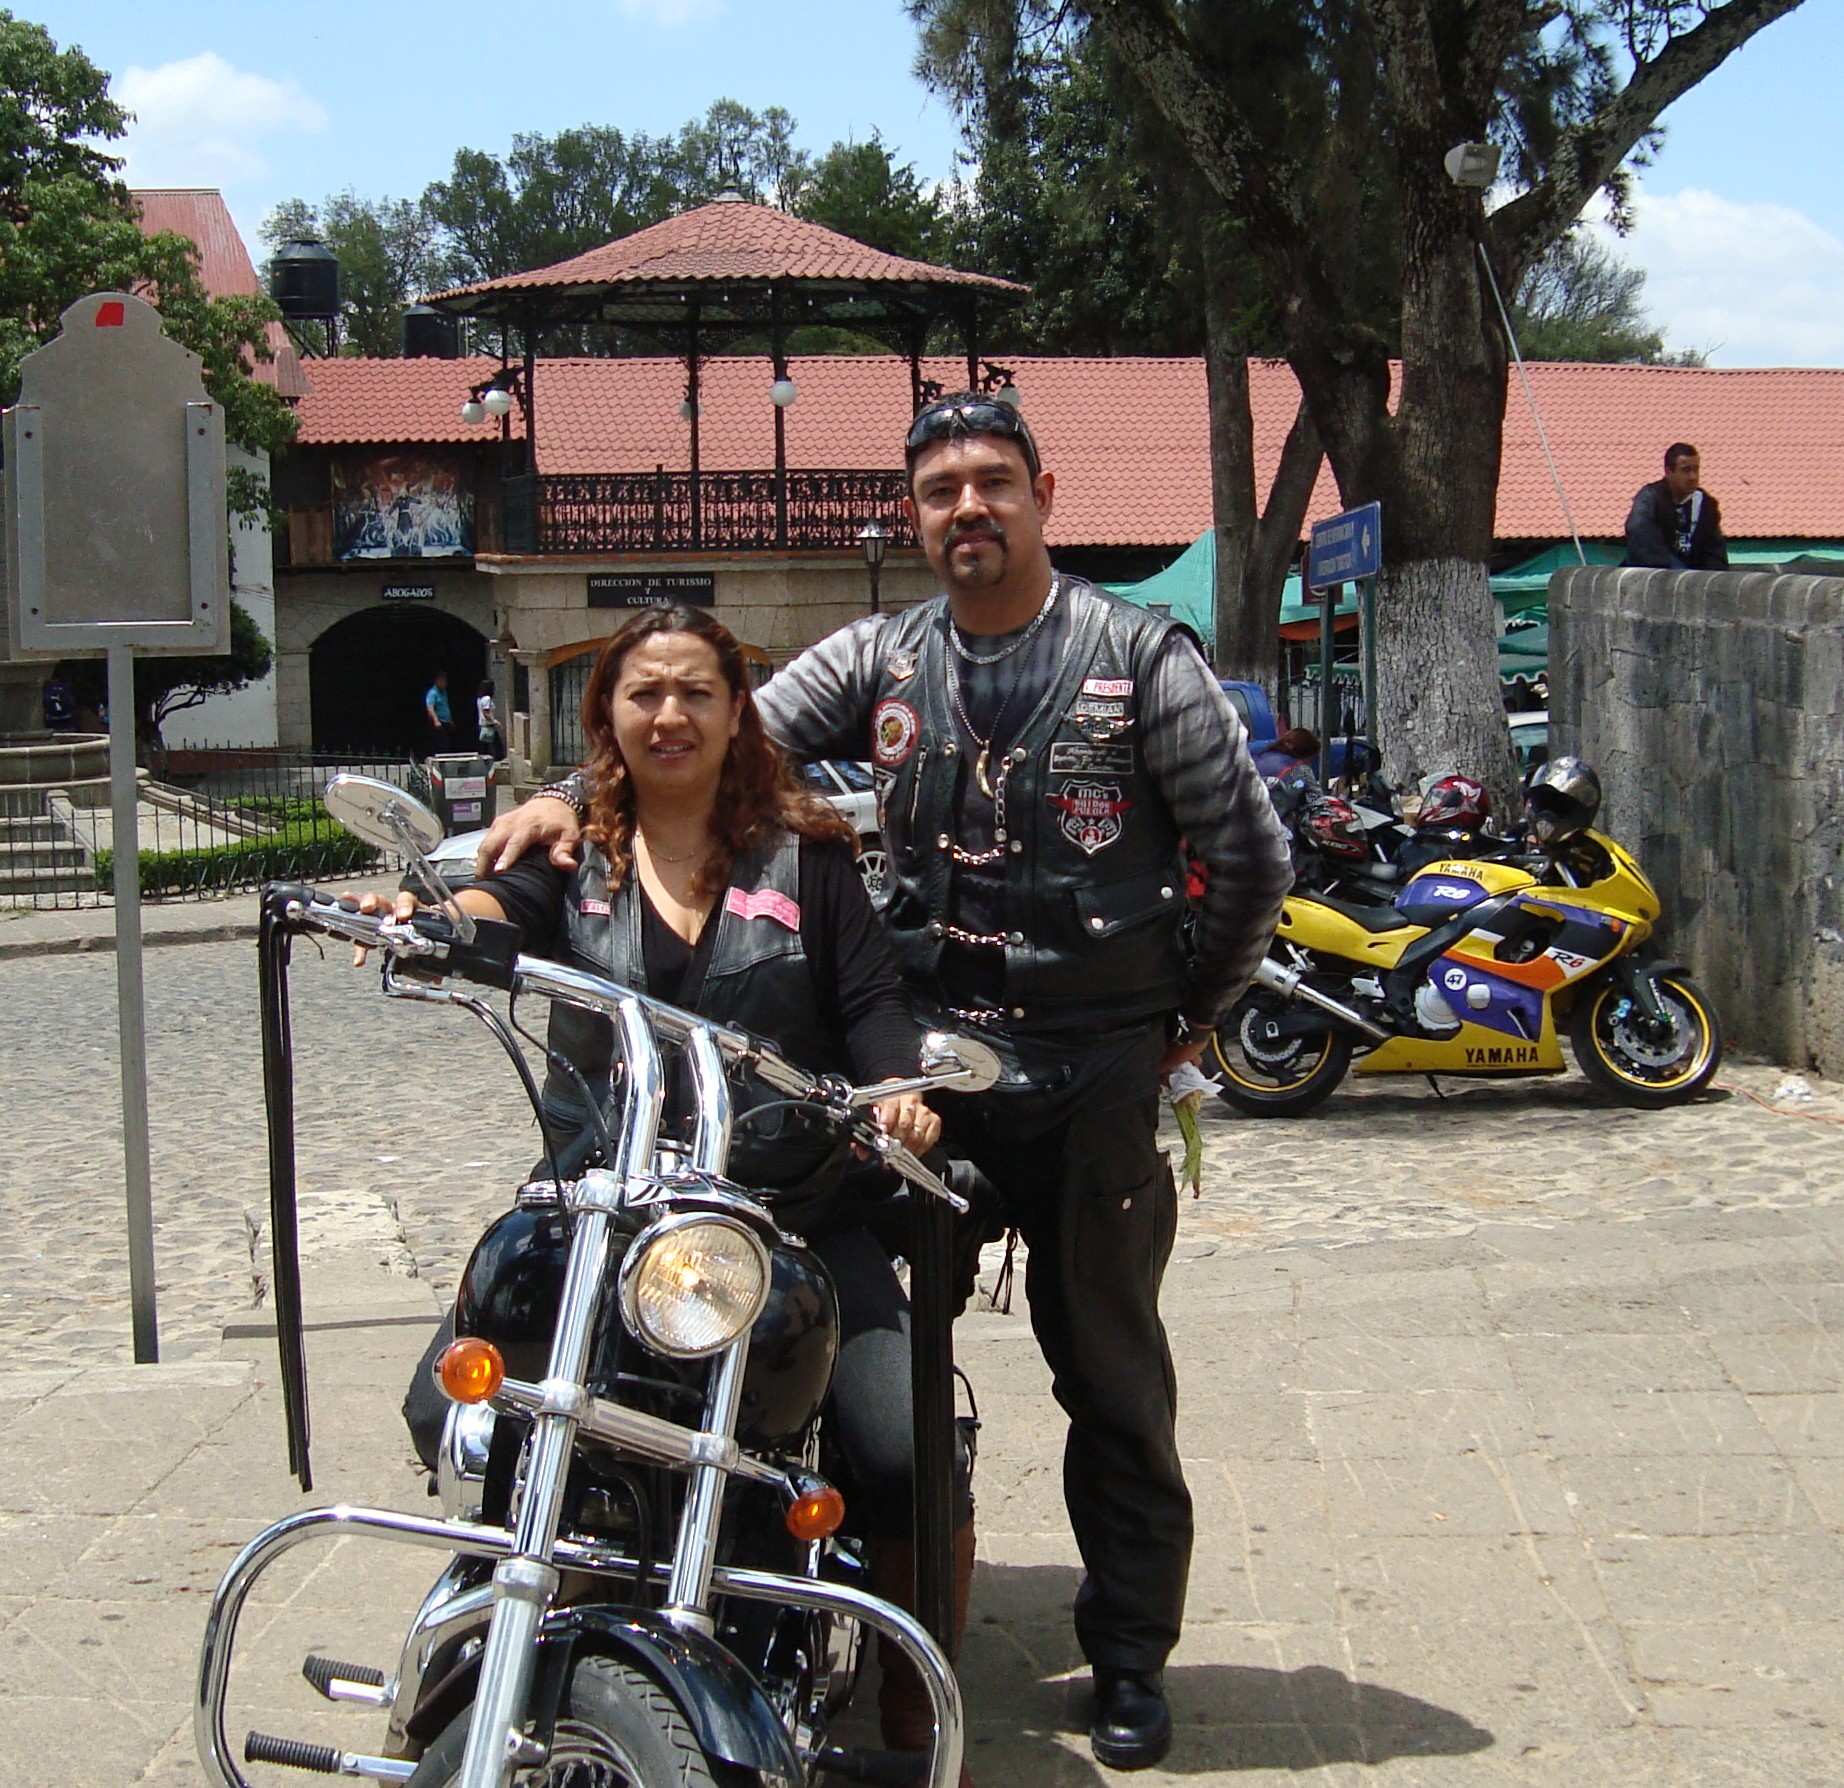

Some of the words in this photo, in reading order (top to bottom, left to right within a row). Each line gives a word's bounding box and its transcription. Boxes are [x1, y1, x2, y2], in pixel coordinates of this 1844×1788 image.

[590, 578, 642, 587] DIRECCION
[648, 578, 661, 587] DE
[666, 577, 711, 587] TURISMO
[384, 588, 433, 598] ABOGADOS
[627, 597, 669, 605] CULTURA
[1440, 863, 1483, 880] YAMAHA
[1433, 886, 1471, 899] R6
[1552, 951, 1586, 968] R6
[1446, 974, 1464, 985] 47
[1465, 1047, 1539, 1064] YAMAHA
